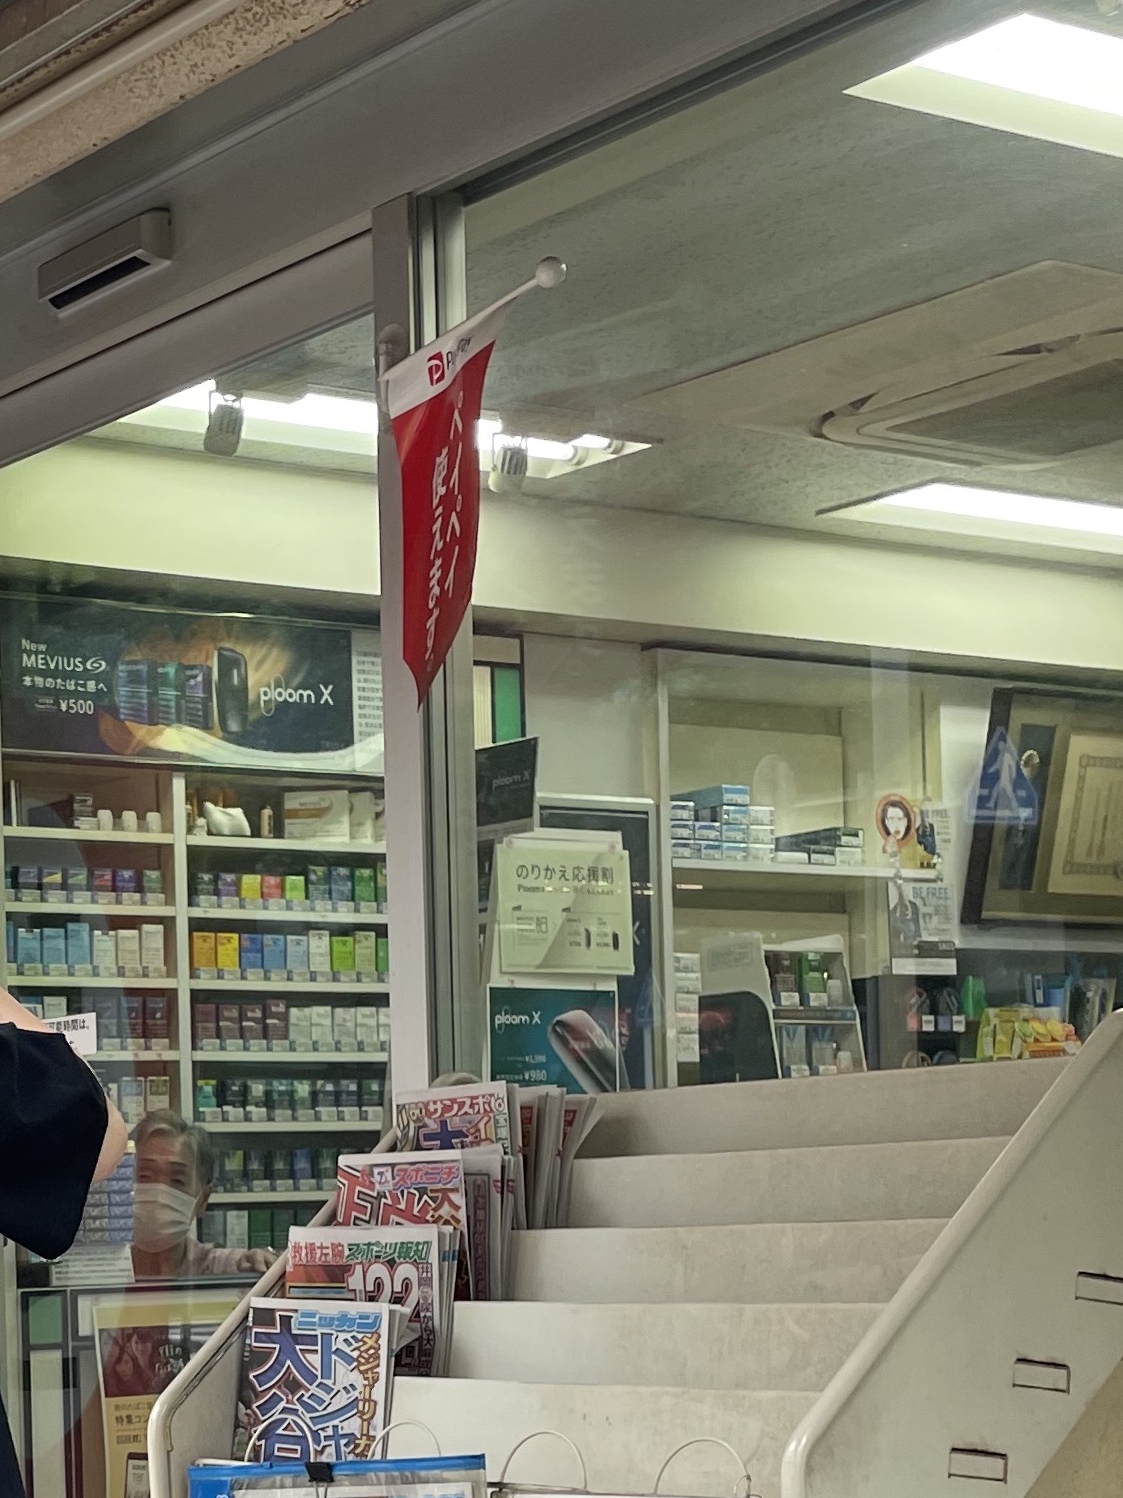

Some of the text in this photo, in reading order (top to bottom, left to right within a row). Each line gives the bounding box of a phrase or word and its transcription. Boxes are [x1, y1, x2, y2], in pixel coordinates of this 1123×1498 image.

[444, 390, 464, 598] ペイペイ
[21, 639, 47, 652] New
[22, 653, 84, 672] MEVIUS
[59, 699, 95, 715] ¥500
[260, 674, 334, 717] ploom X
[516, 864, 614, 884] のりかえ応援割
[494, 1005, 530, 1034] ploom
[428, 1094, 493, 1119] サンスポ
[393, 1164, 460, 1188] スポニチ
[345, 1241, 432, 1262] スポーツ報知
[296, 1309, 382, 1332] ニッカン
